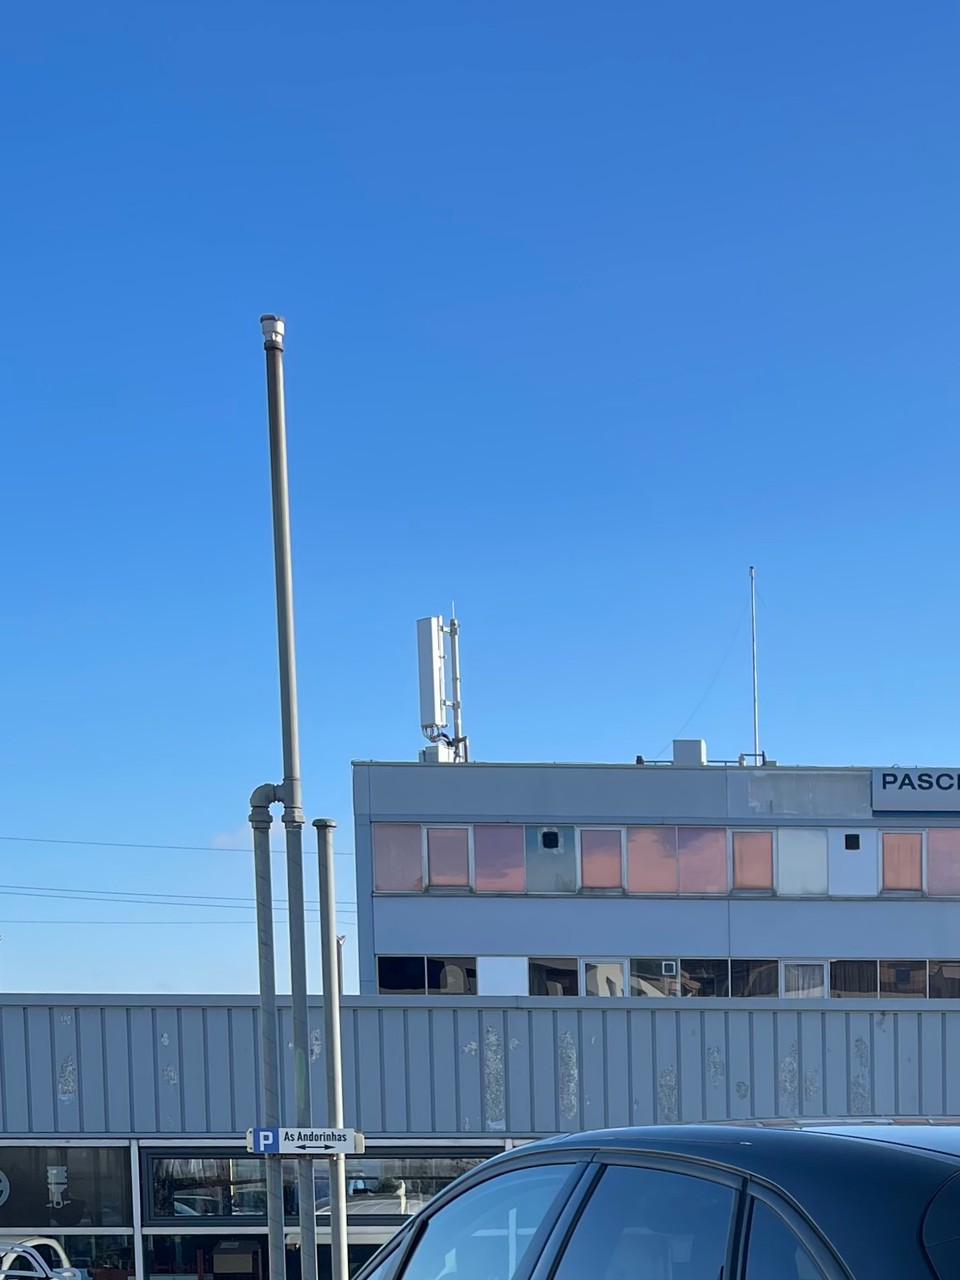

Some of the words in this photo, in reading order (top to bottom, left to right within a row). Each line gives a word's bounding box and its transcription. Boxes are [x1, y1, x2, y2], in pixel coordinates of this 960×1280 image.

[259, 1131, 273, 1151] P
[284, 1131, 295, 1142] As
[297, 1131, 347, 1142] Andorinhas
